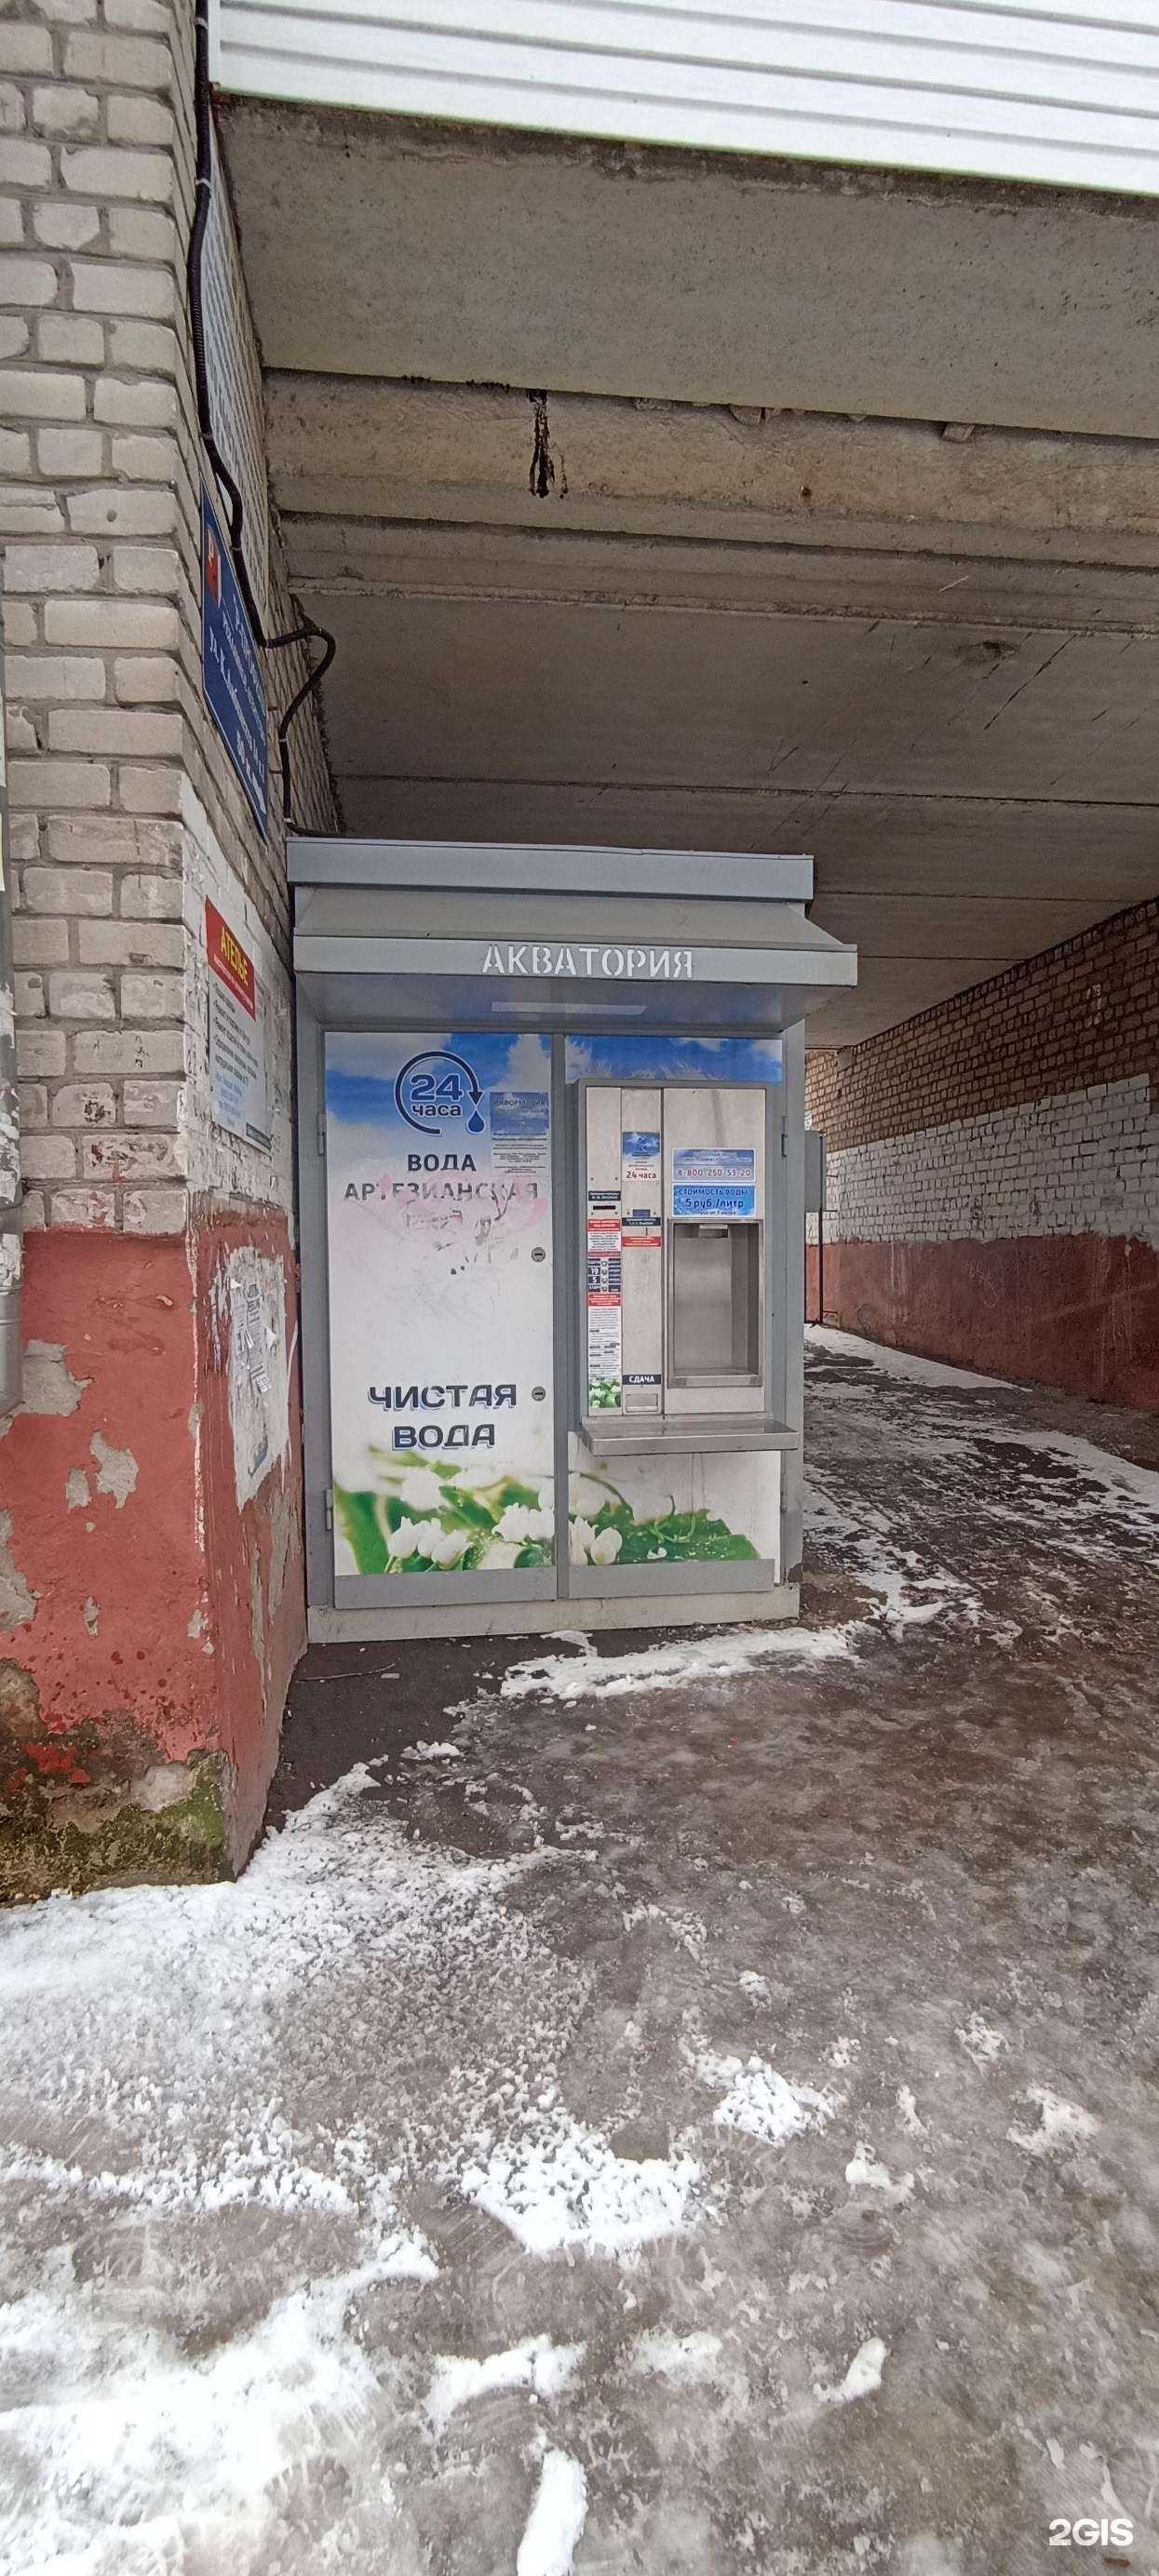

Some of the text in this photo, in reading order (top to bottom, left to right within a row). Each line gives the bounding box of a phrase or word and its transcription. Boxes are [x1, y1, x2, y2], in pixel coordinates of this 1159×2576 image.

[219, 927, 249, 987] АТЕЛЬЕ
[482, 944, 694, 978] АКВАТОРИЯ
[411, 1074, 463, 1102] 24
[411, 1104, 462, 1118] часа
[407, 1154, 477, 1173] ВОДА
[626, 1171, 656, 1180] 24 часа
[685, 1198, 692, 1207] 5
[628, 1375, 655, 1384] СДАЧА
[368, 1384, 518, 1412] ЧИСТАЯ
[392, 1423, 497, 1451] ВОДА
